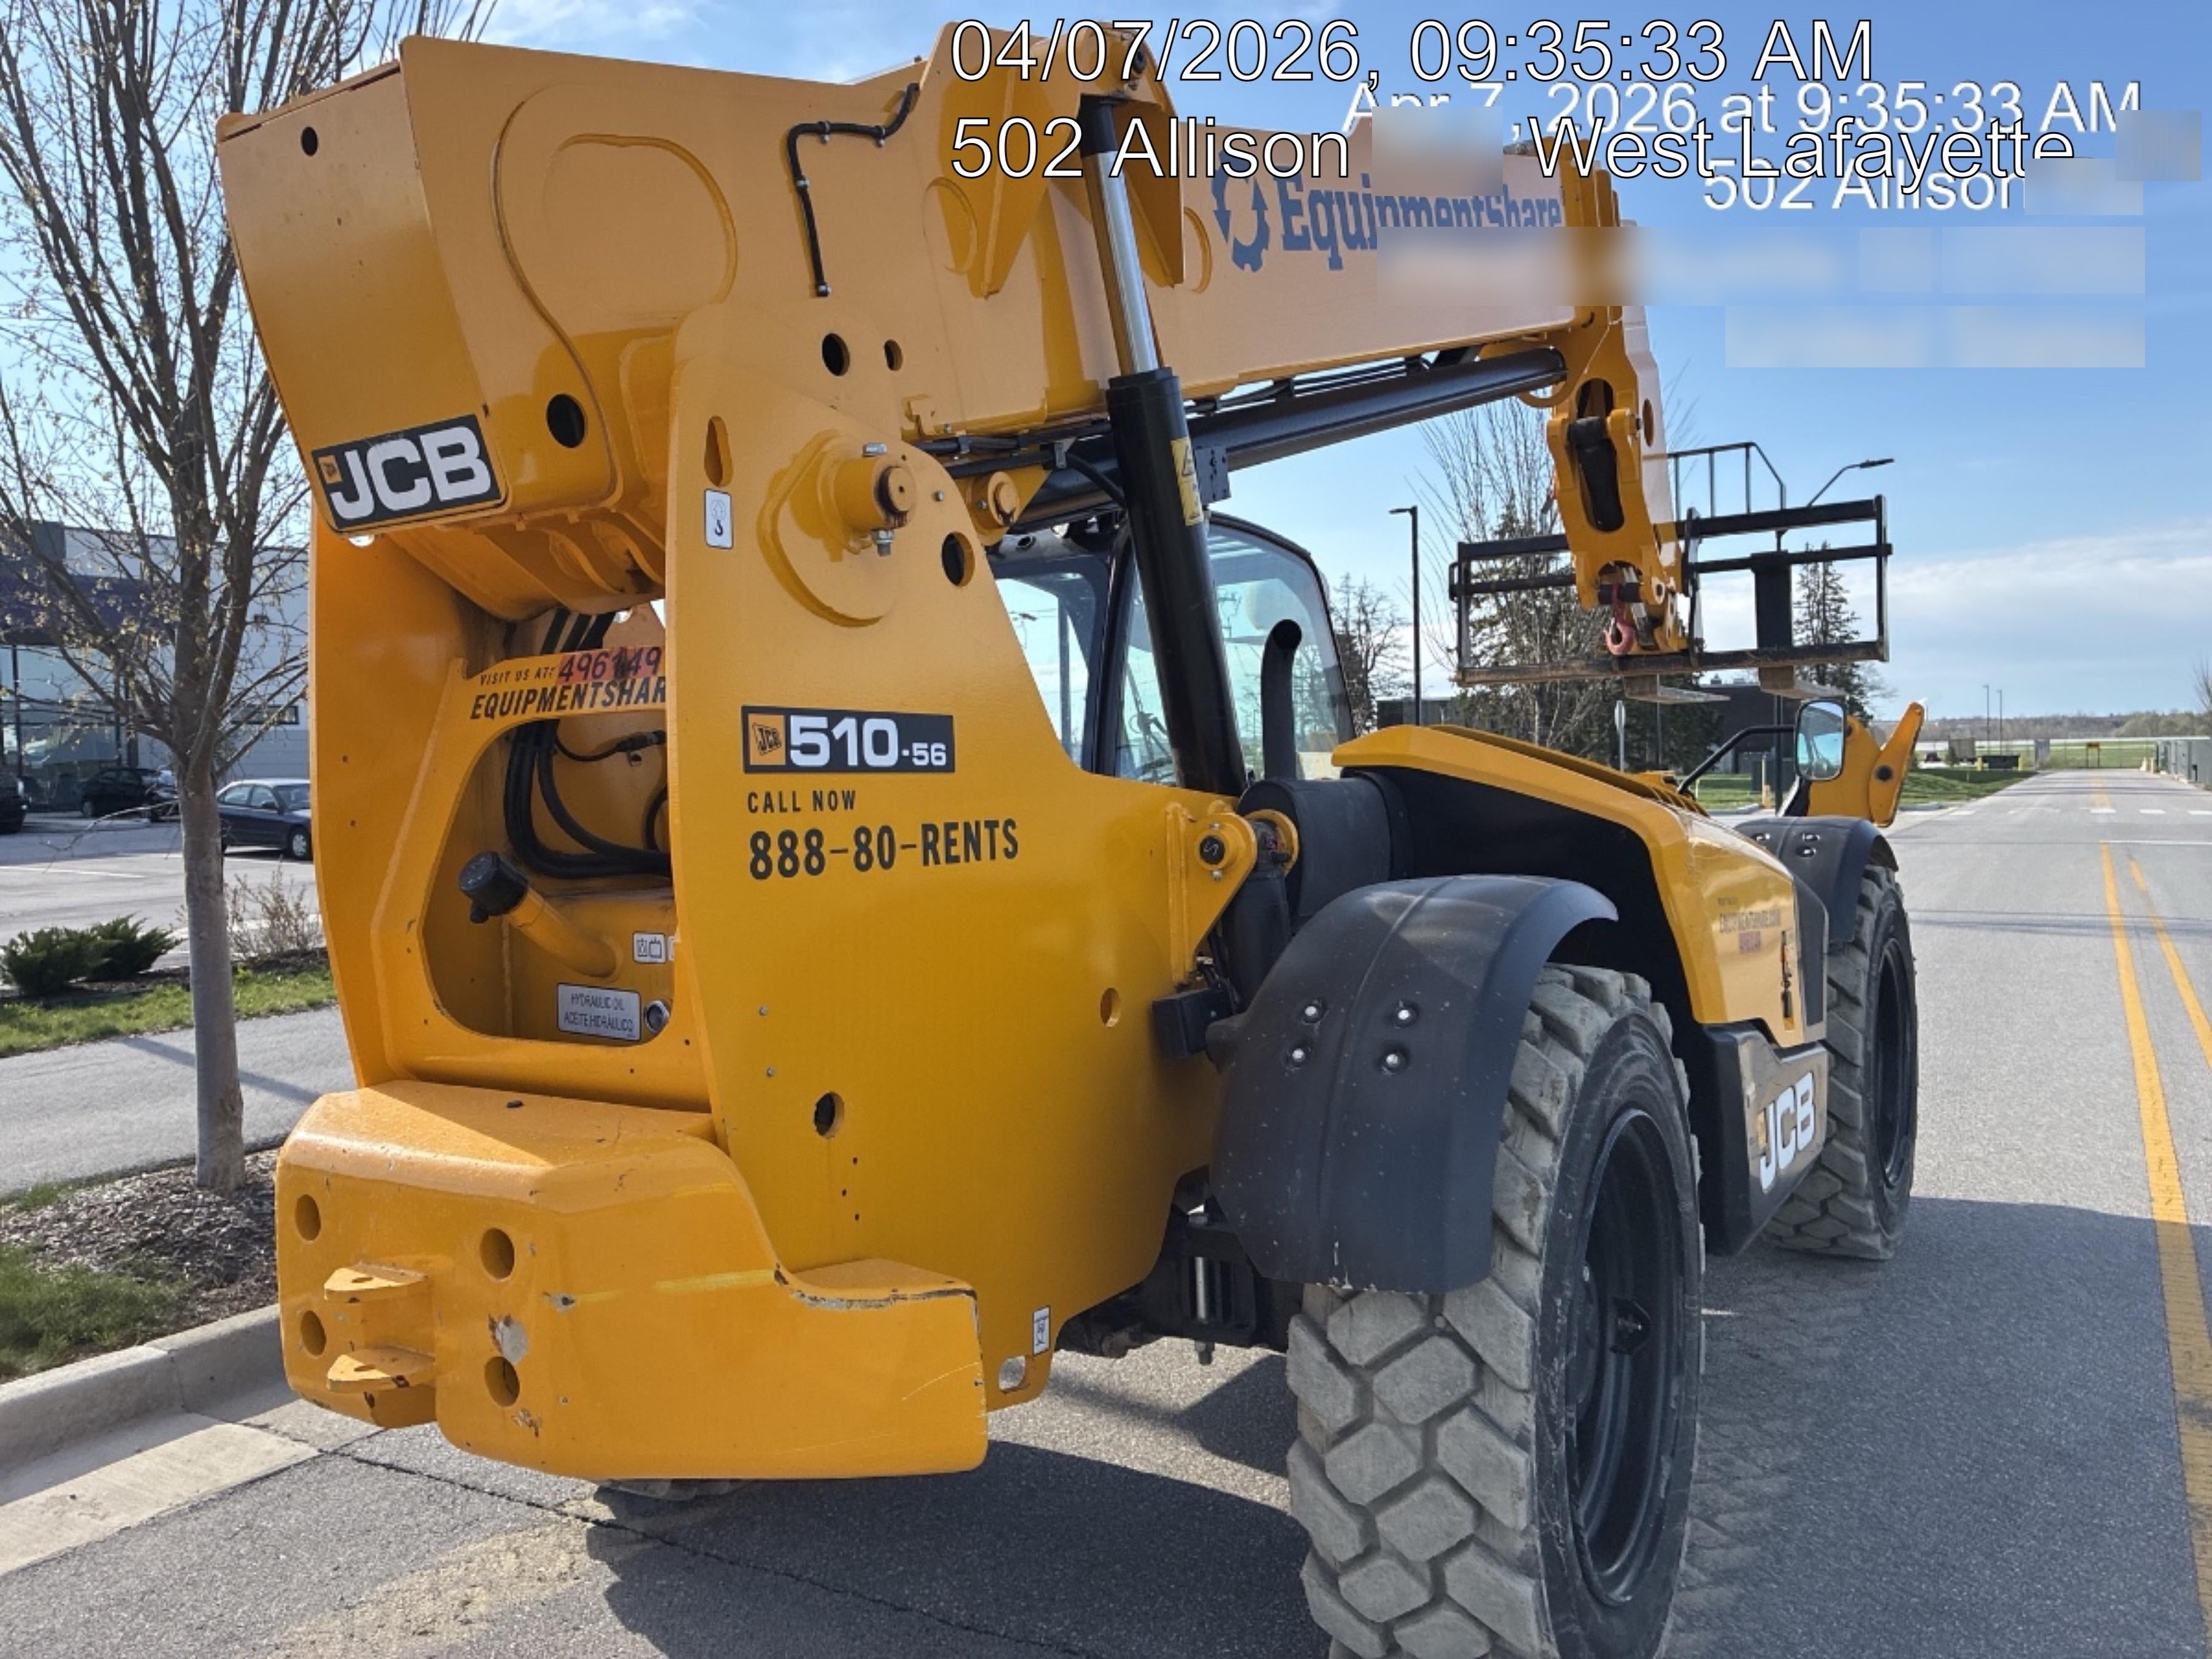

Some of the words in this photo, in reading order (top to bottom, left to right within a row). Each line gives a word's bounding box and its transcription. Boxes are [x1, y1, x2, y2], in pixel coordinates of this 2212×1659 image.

[329, 426, 492, 520] JCB
[480, 670, 511, 686] VISIT
[515, 669, 530, 682] US
[748, 791, 801, 813] CALL
[812, 790, 856, 811] NOW
[750, 818, 1019, 880] 888-80-RENTS
[1760, 1072, 1814, 1193] JCB
